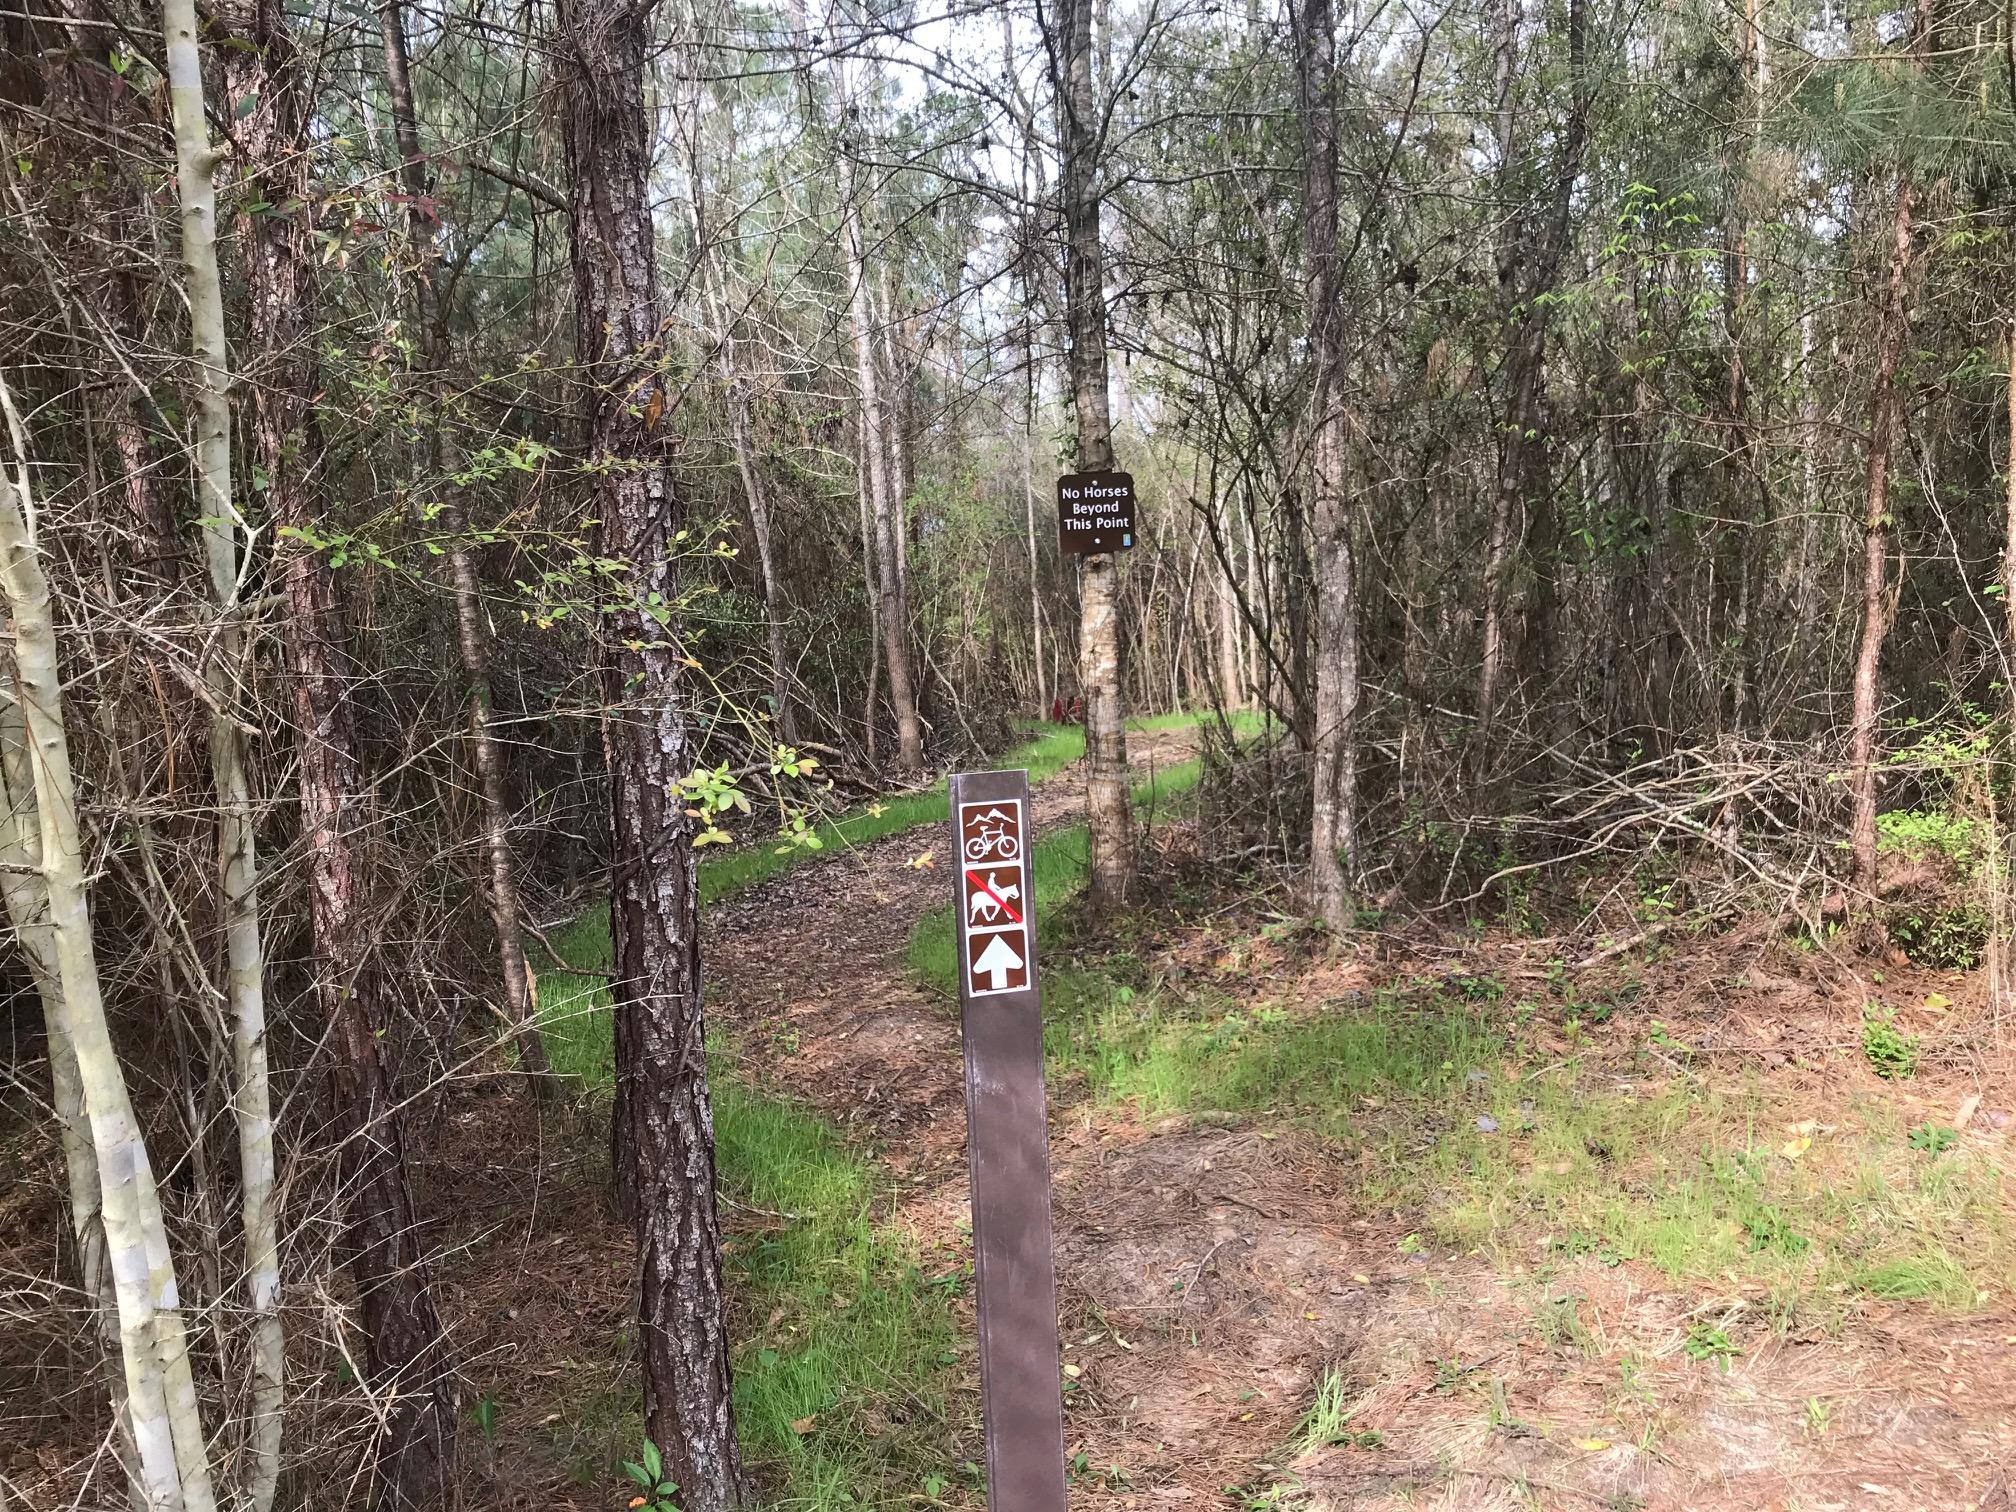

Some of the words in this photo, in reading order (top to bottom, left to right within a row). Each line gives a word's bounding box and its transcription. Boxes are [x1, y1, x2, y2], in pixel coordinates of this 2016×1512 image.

[1062, 488, 1080, 499] No
[1084, 487, 1128, 498] Horses
[1073, 501, 1119, 516] Beyond
[1064, 518, 1092, 530] This
[1096, 517, 1129, 528] Point
